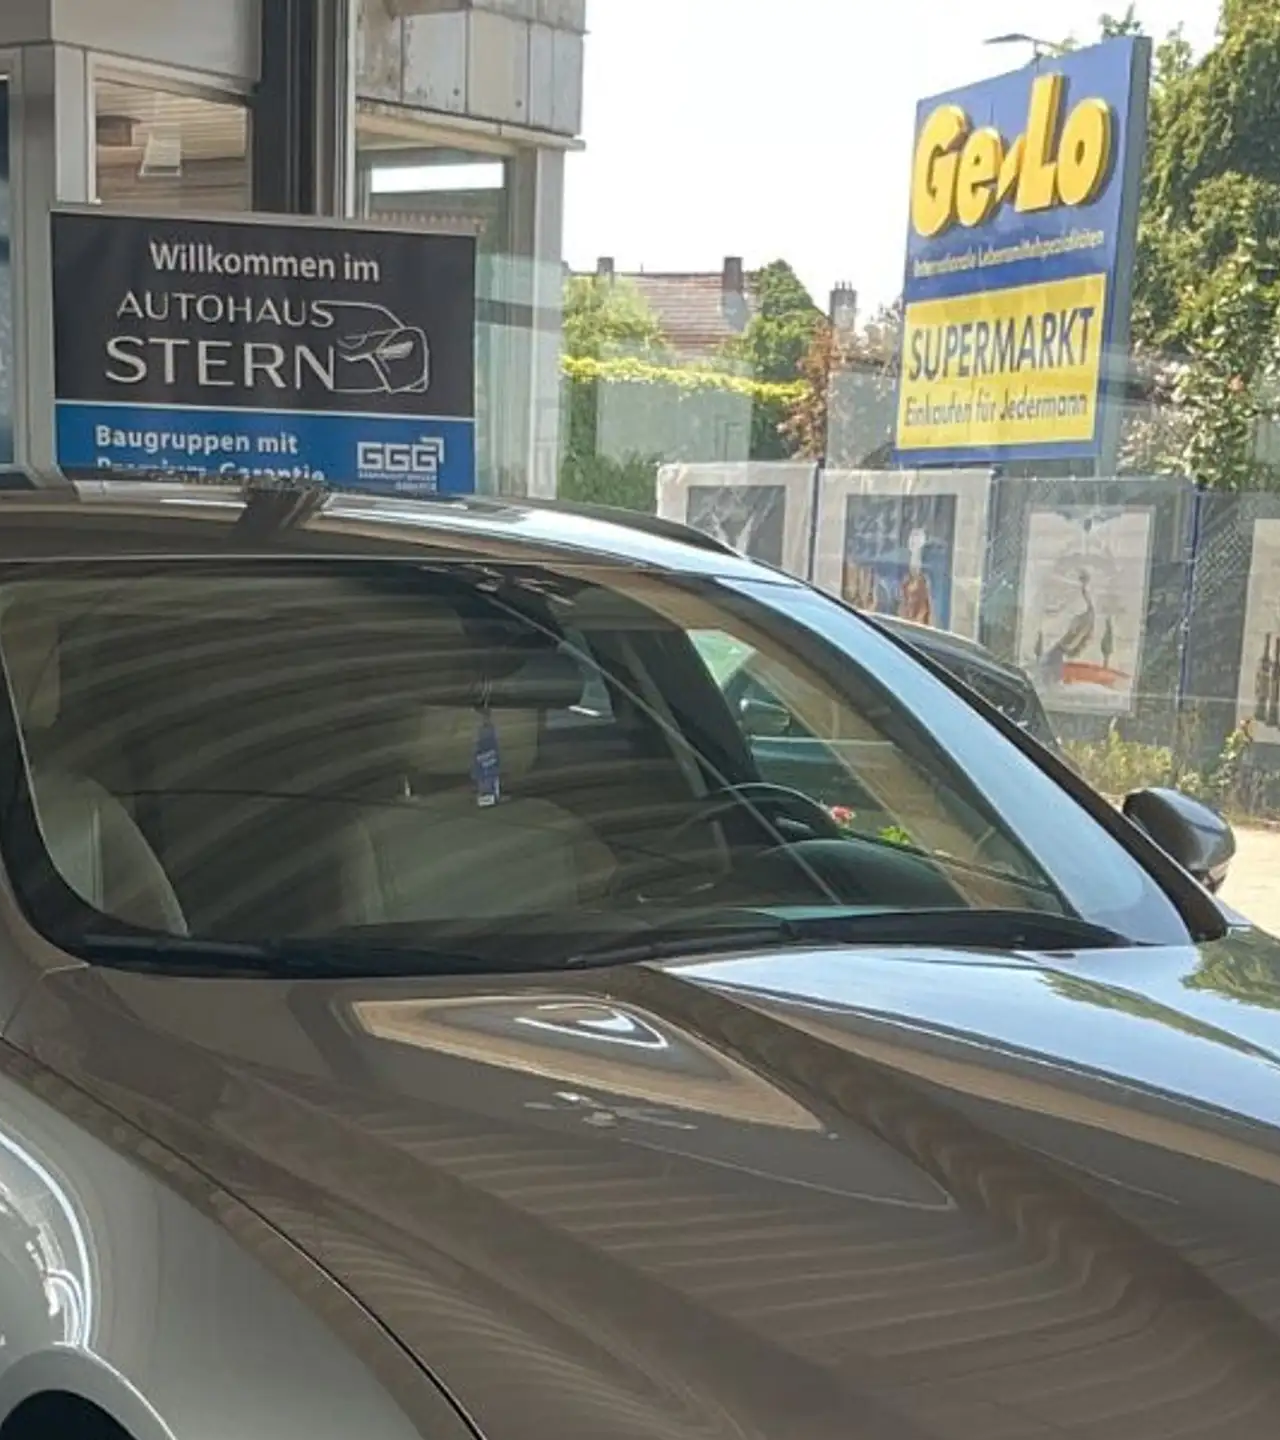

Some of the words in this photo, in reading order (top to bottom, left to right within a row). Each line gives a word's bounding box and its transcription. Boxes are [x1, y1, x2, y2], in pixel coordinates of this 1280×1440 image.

[150, 241, 334, 279] Willkommen
[344, 252, 380, 282] im
[116, 290, 334, 328] AUTOHAUS
[908, 306, 1094, 382] SUPERMARKT
[105, 336, 335, 391] STERN
[1000, 385, 1088, 421] Jedermann
[95, 424, 250, 456] Baugruppen
[257, 431, 298, 454] mit
[357, 438, 442, 472] GGG
